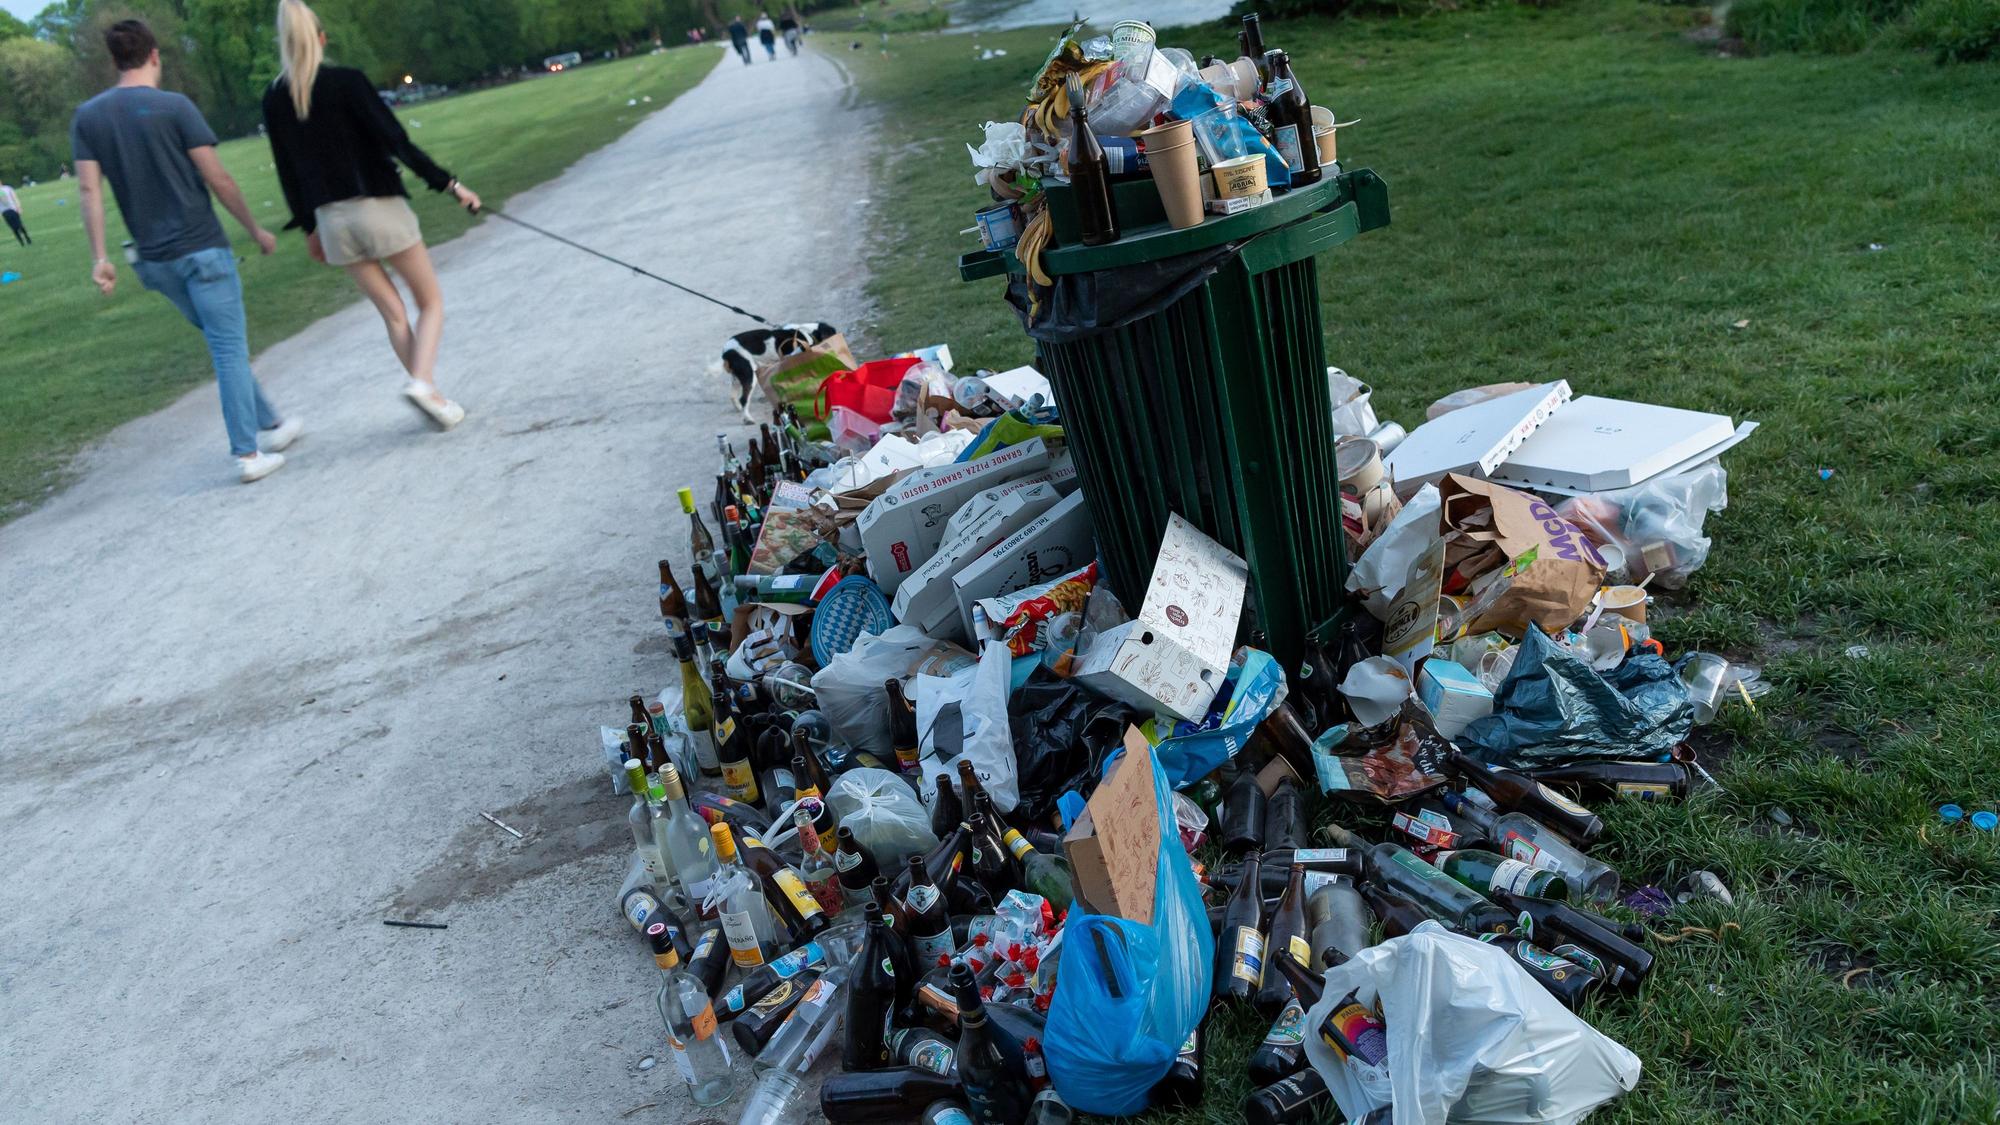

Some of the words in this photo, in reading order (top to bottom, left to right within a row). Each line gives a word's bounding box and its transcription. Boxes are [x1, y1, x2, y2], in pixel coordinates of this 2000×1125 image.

[992, 449, 1023, 466] GRANDE
[963, 462, 990, 476] PIZZA,
[932, 471, 963, 488] GRANDE
[901, 486, 930, 501] GUSTO!
[1023, 525, 1037, 537] 089
[1527, 496, 1582, 562] MCD
